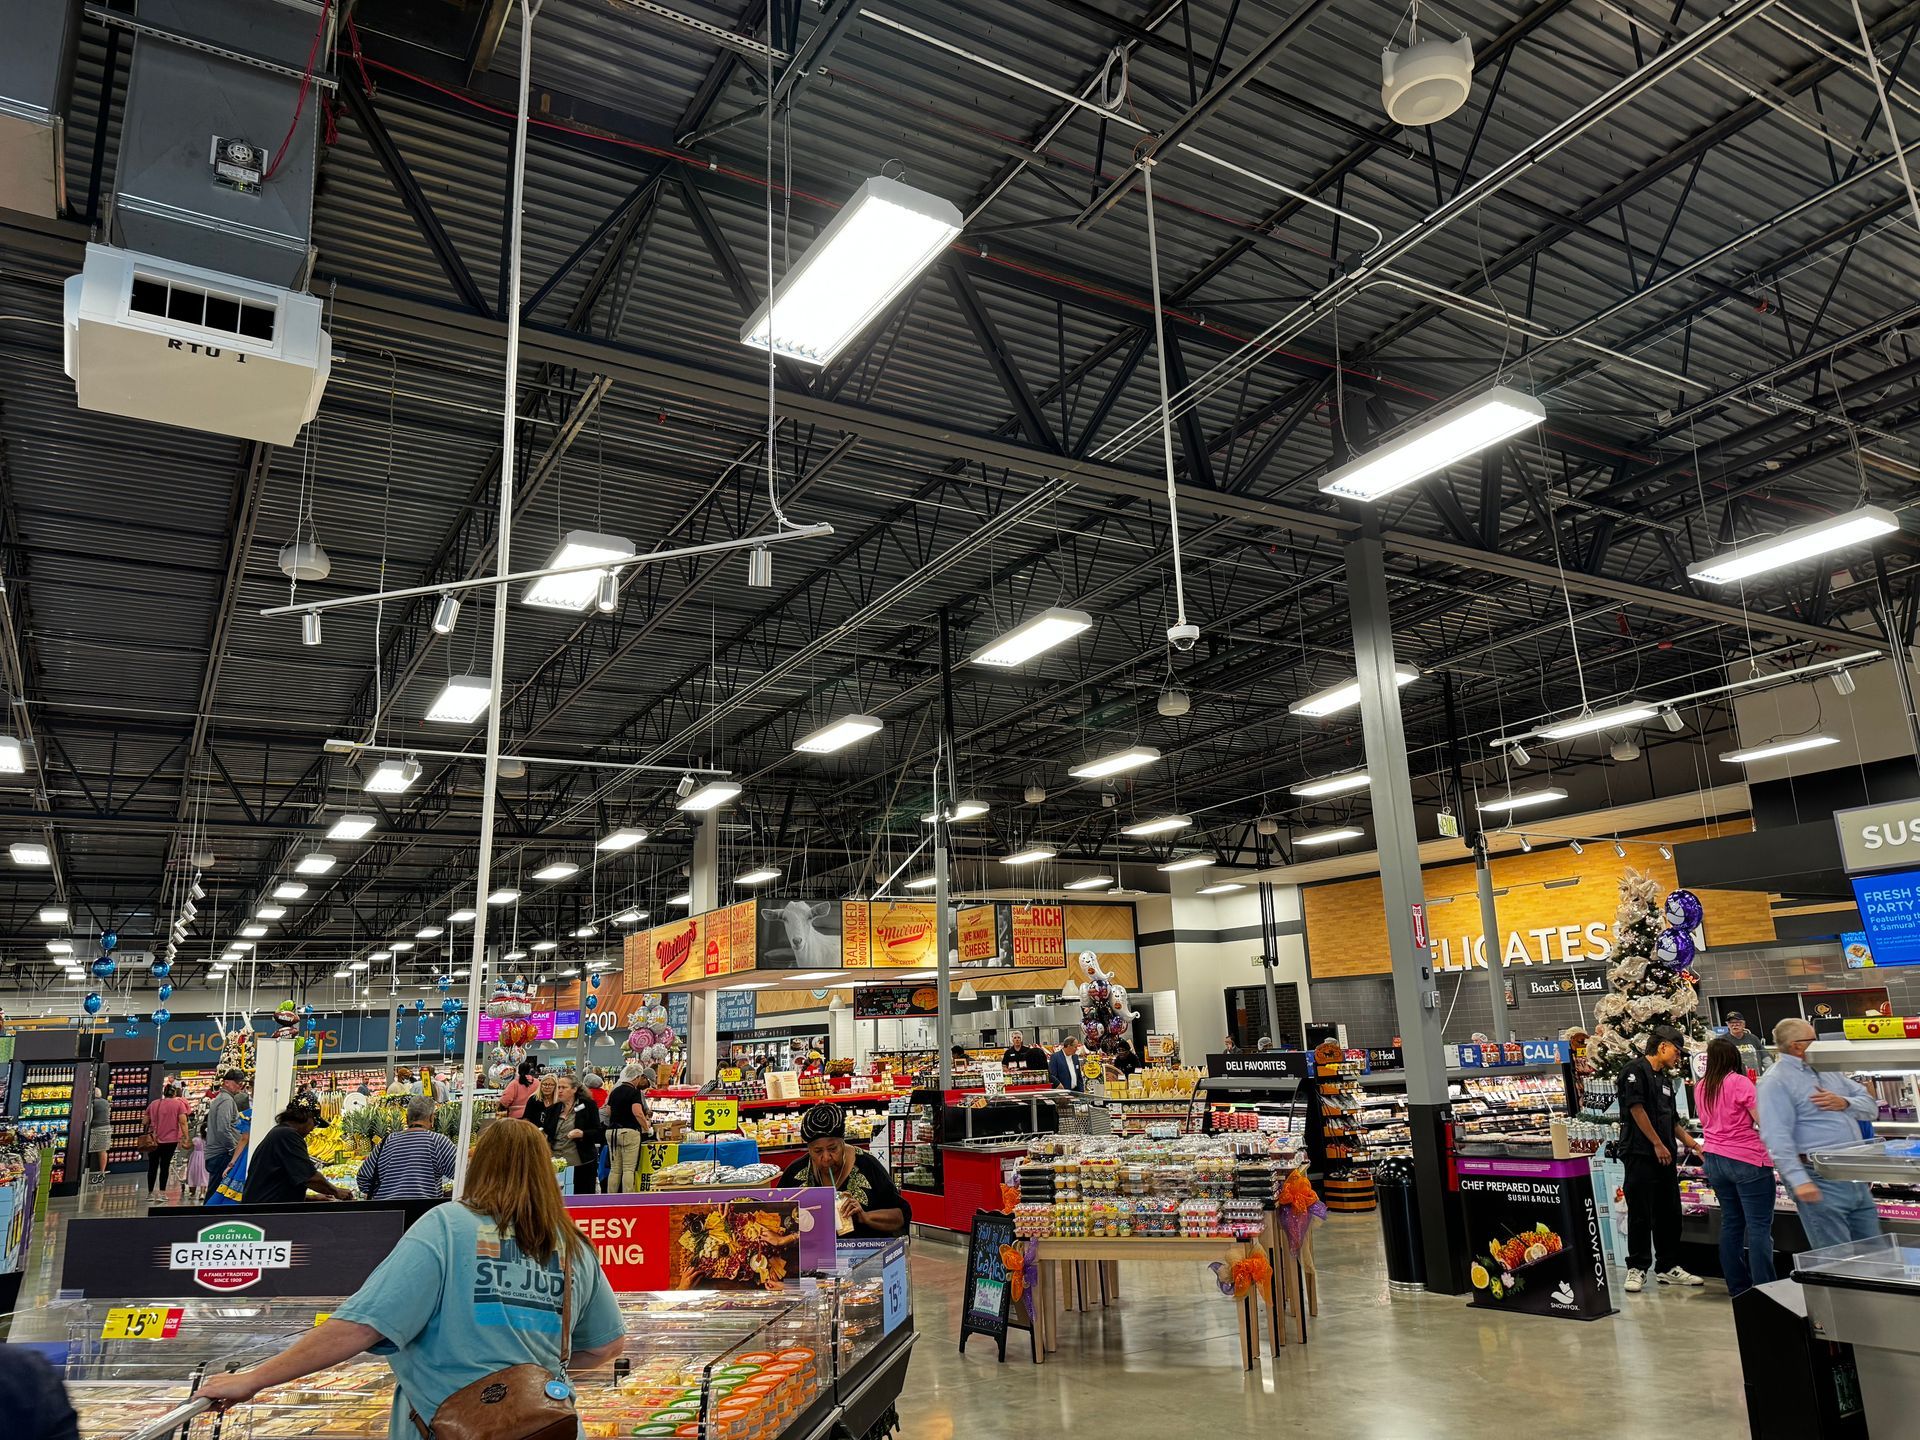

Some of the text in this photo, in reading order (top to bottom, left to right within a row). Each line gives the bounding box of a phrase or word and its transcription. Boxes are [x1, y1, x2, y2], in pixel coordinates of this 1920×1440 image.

[168, 338, 246, 363] RTU 1
[1864, 888, 1911, 902] FRESH
[1867, 900, 1914, 914] PARTY
[858, 903, 867, 930] CREAMY
[1033, 908, 1061, 926] RICH
[1871, 914, 1912, 923] Featuring
[845, 902, 858, 966] BALANCED
[877, 919, 933, 948] Murray's
[963, 928, 989, 942] WE KNOW
[1014, 928, 1033, 936] SHARP
[858, 939, 867, 966] SMOOTH
[964, 942, 990, 957] CHEESE
[1015, 937, 1062, 954] BUTTERY
[1015, 954, 1064, 965] Herbaceous
[1531, 977, 1602, 994] Boar's Head
[1378, 1050, 1396, 1059] Head
[1226, 1060, 1287, 1070] DELI FAVORITES
[1461, 1180, 1560, 1194] CHEF PREPARED DAILY
[575, 1217, 638, 1239] EESY
[1584, 1198, 1605, 1288] SNOWFOX
[175, 1246, 286, 1264] GRISANTI'S
[475, 1262, 574, 1297] ST. JUD
